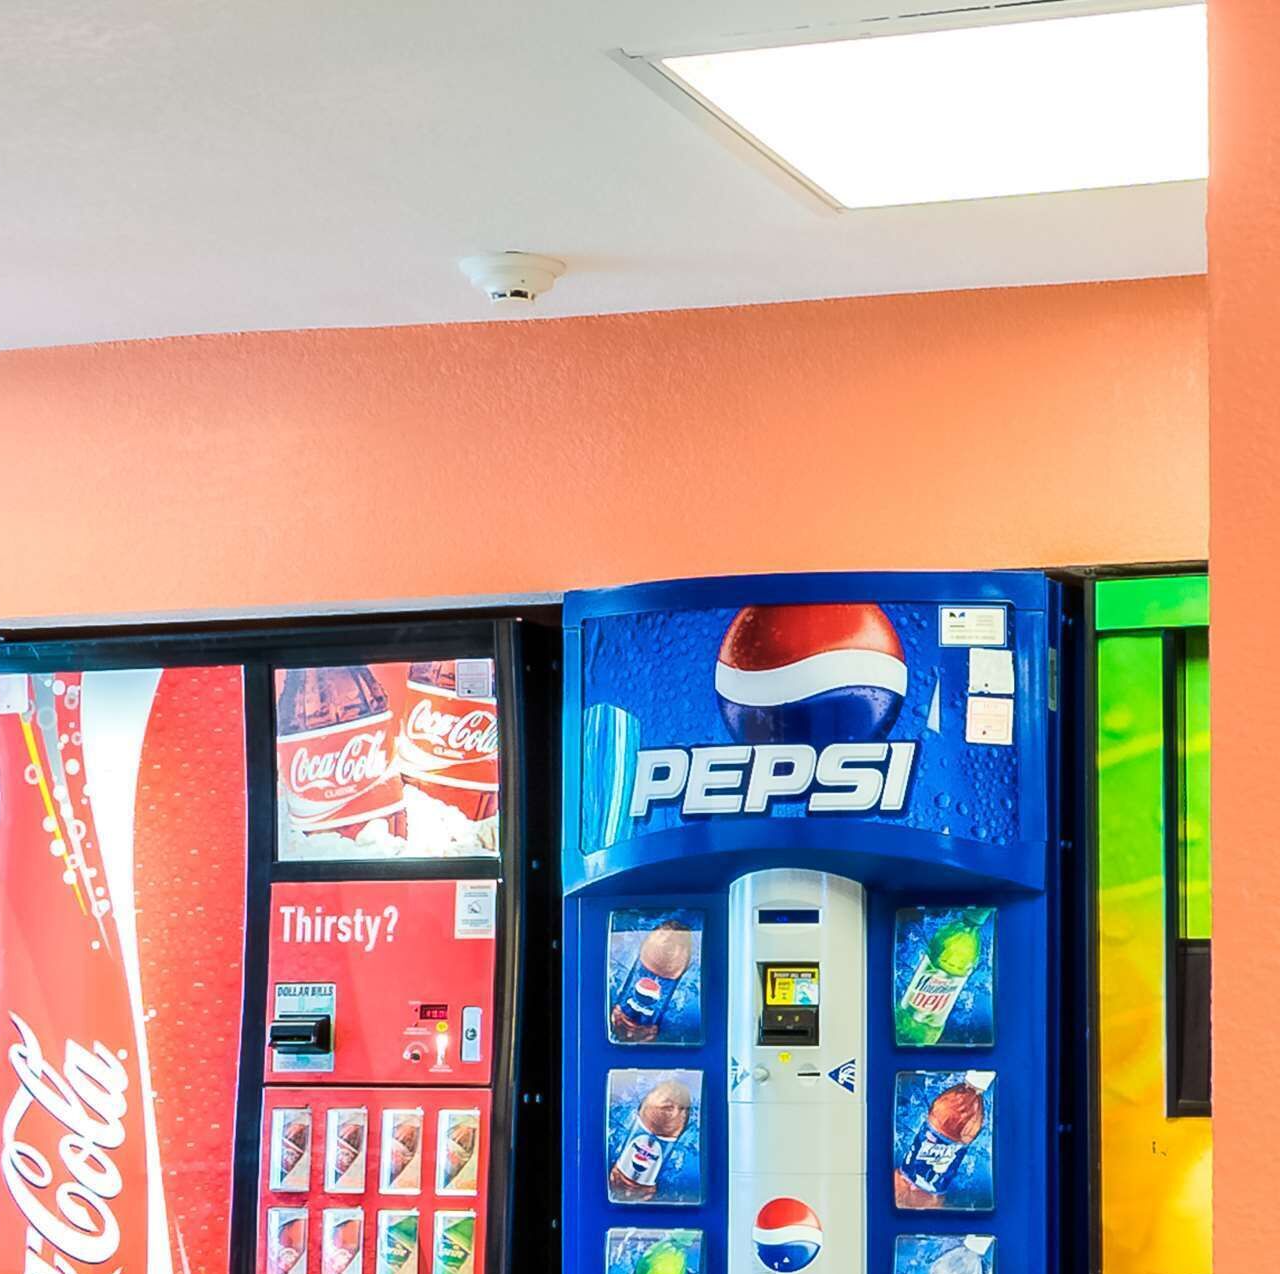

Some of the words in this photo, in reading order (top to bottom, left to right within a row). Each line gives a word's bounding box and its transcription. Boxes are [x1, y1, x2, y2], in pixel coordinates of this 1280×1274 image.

[629, 742, 916, 817] PEPSI
[279, 904, 400, 953] Thirsty?
[277, 986, 310, 997] DOLLAR
[311, 985, 334, 997] BILLS
